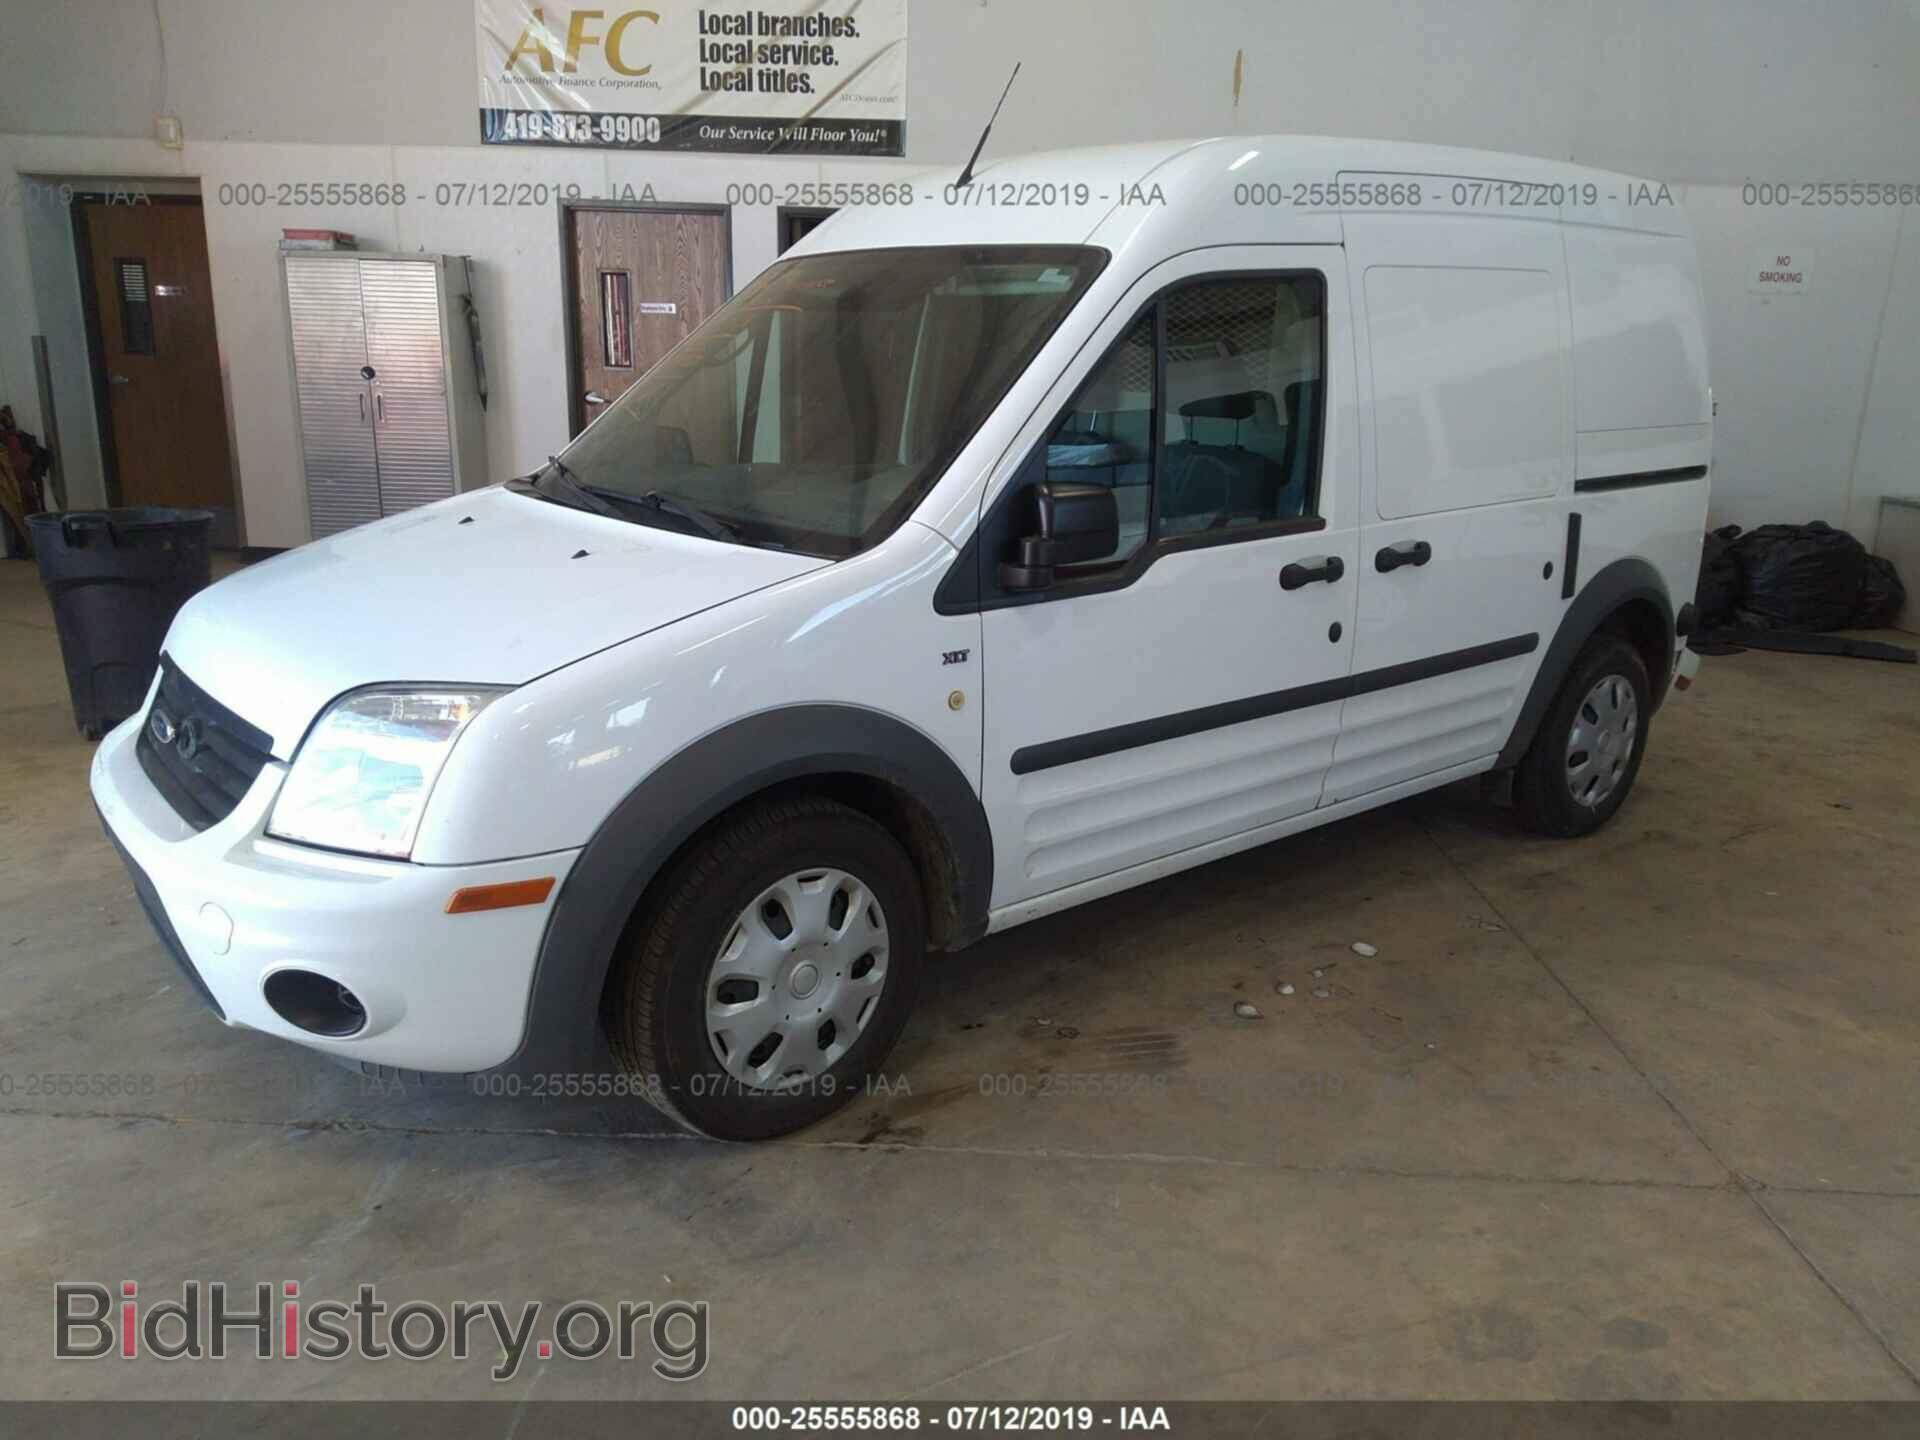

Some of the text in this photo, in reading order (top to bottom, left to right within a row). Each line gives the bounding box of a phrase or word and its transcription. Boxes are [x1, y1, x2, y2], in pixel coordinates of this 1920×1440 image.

[699, 9, 860, 38] Local branches.
[505, 8, 660, 77] AFC
[699, 38, 839, 66] Local service.
[558, 77, 595, 87] Finance
[700, 67, 815, 94] Local titles.
[699, 125, 725, 140] Our
[728, 126, 775, 141] Service
[810, 127, 847, 142] Floor
[1776, 255, 1791, 266] NO
[1759, 271, 1803, 283] SMOKING
[942, 648, 970, 666] XLT
